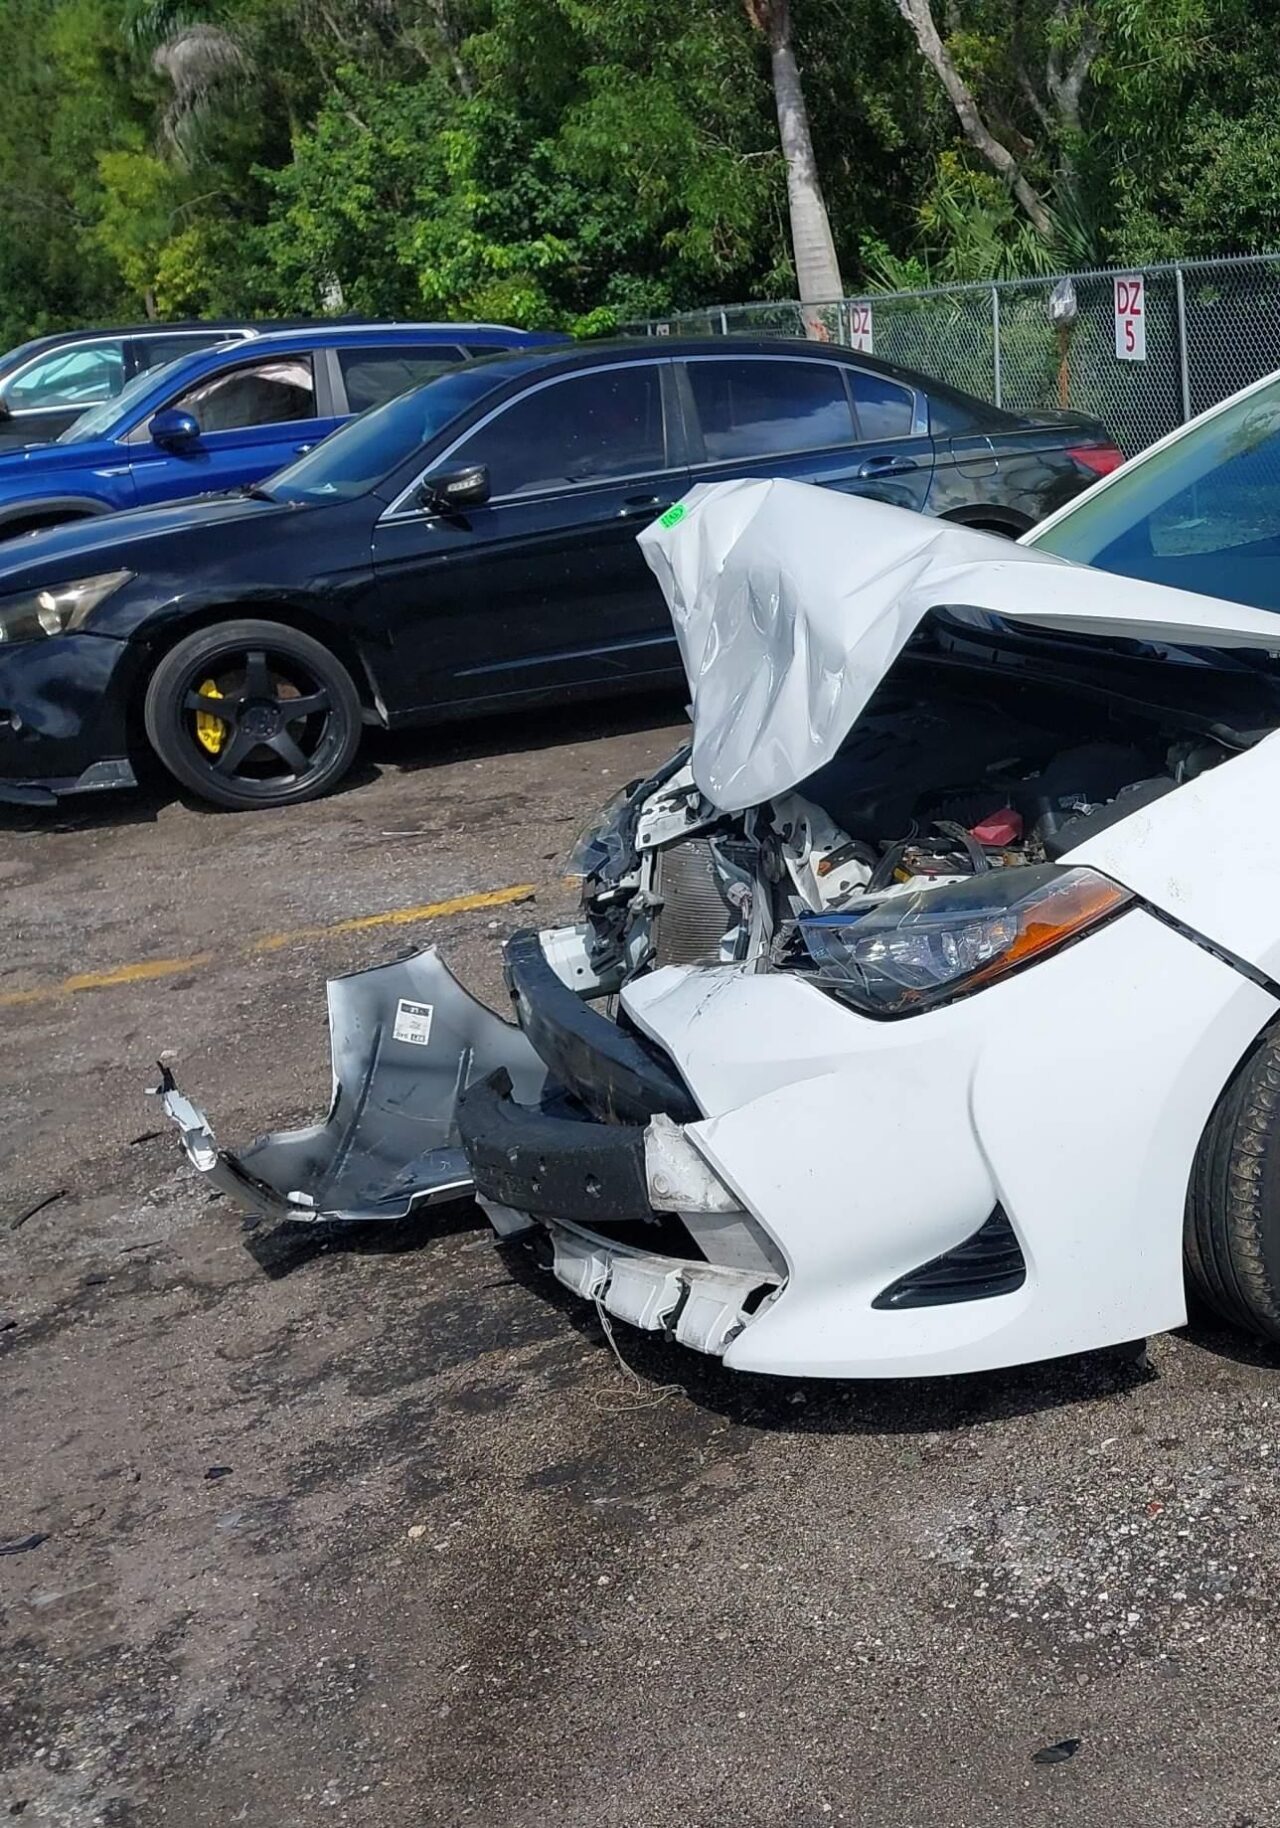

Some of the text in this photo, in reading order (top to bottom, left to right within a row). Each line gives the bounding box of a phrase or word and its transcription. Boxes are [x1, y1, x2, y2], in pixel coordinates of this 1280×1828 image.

[1117, 281, 1141, 315] DZ
[852, 308, 870, 334] DZ
[1126, 320, 1135, 352] 5
